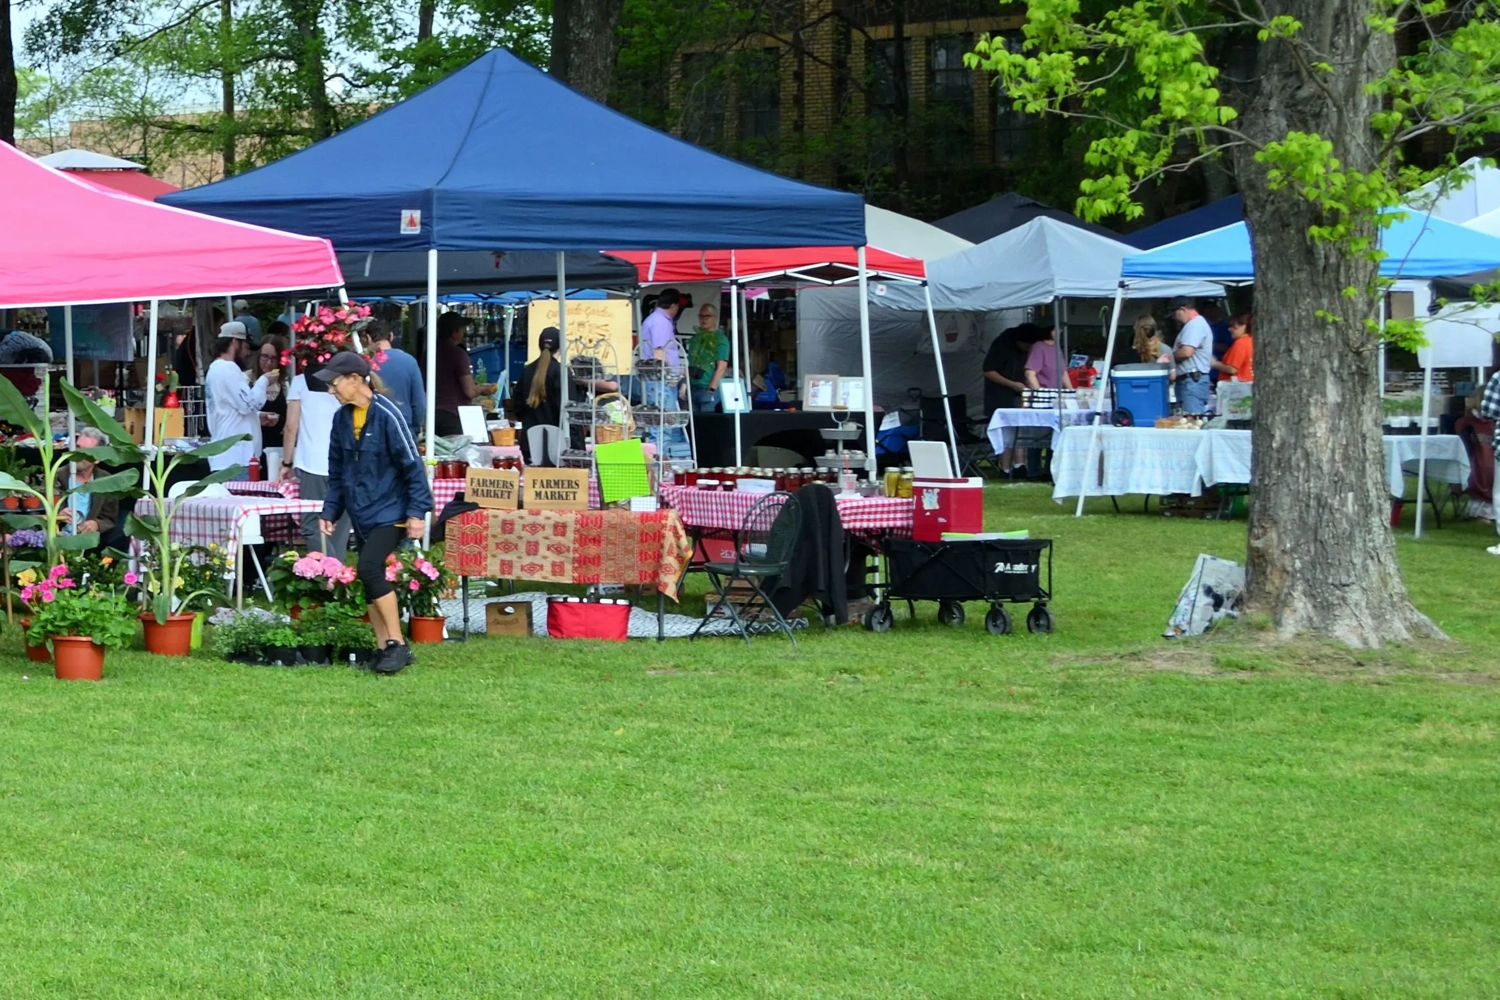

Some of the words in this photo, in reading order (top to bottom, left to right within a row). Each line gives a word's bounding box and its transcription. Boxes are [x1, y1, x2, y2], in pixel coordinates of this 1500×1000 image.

[470, 478, 515, 490] FARMERS
[532, 479, 580, 490] FARMERS
[471, 488, 513, 500] MARKET
[534, 490, 578, 501] MARKET
